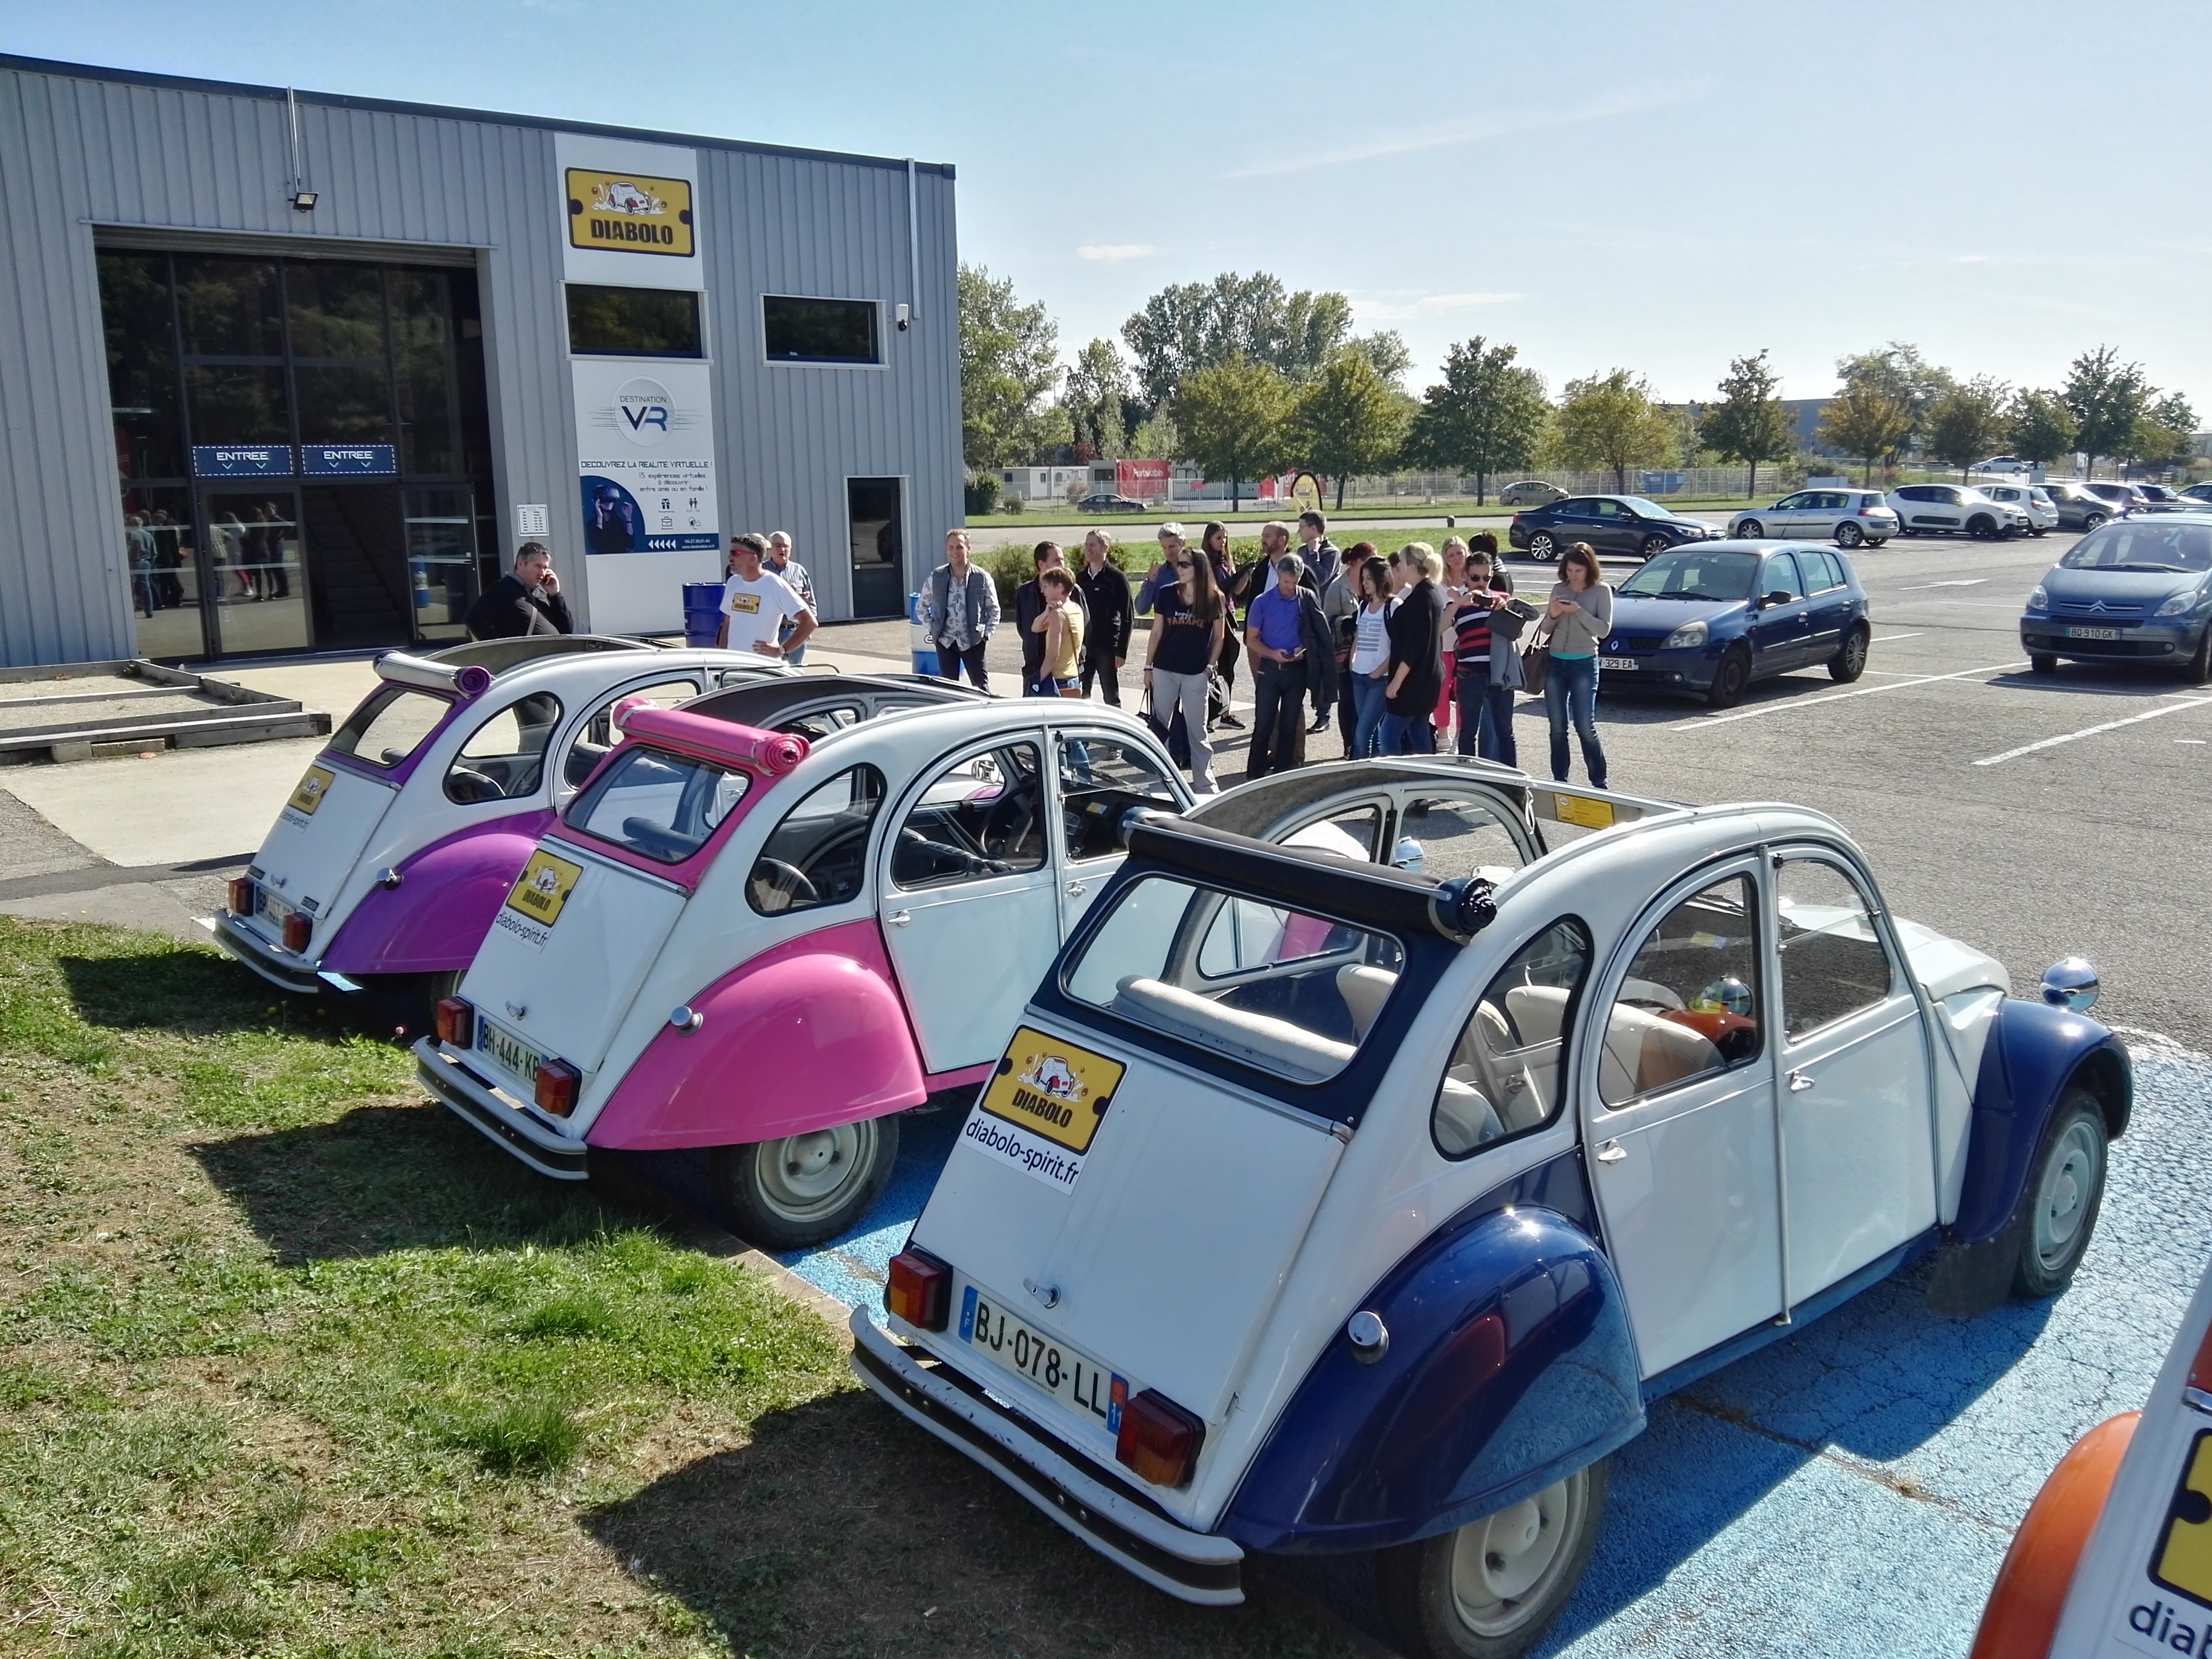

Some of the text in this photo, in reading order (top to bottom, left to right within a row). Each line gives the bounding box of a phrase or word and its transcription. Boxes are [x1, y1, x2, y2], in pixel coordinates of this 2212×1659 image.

[590, 218, 673, 245] DIABOLO
[621, 406, 668, 431] VR
[216, 451, 268, 460] ENTREE
[2071, 628, 2113, 639] BQ-910-GK
[522, 889, 551, 911] DIABOLO
[496, 911, 547, 946] diabolo-spirit.fr
[1012, 1088, 1073, 1128] DIABOLO
[966, 1118, 1079, 1185] diabolo-spirit.fr
[975, 1301, 1107, 1419] BJ-078-LL
